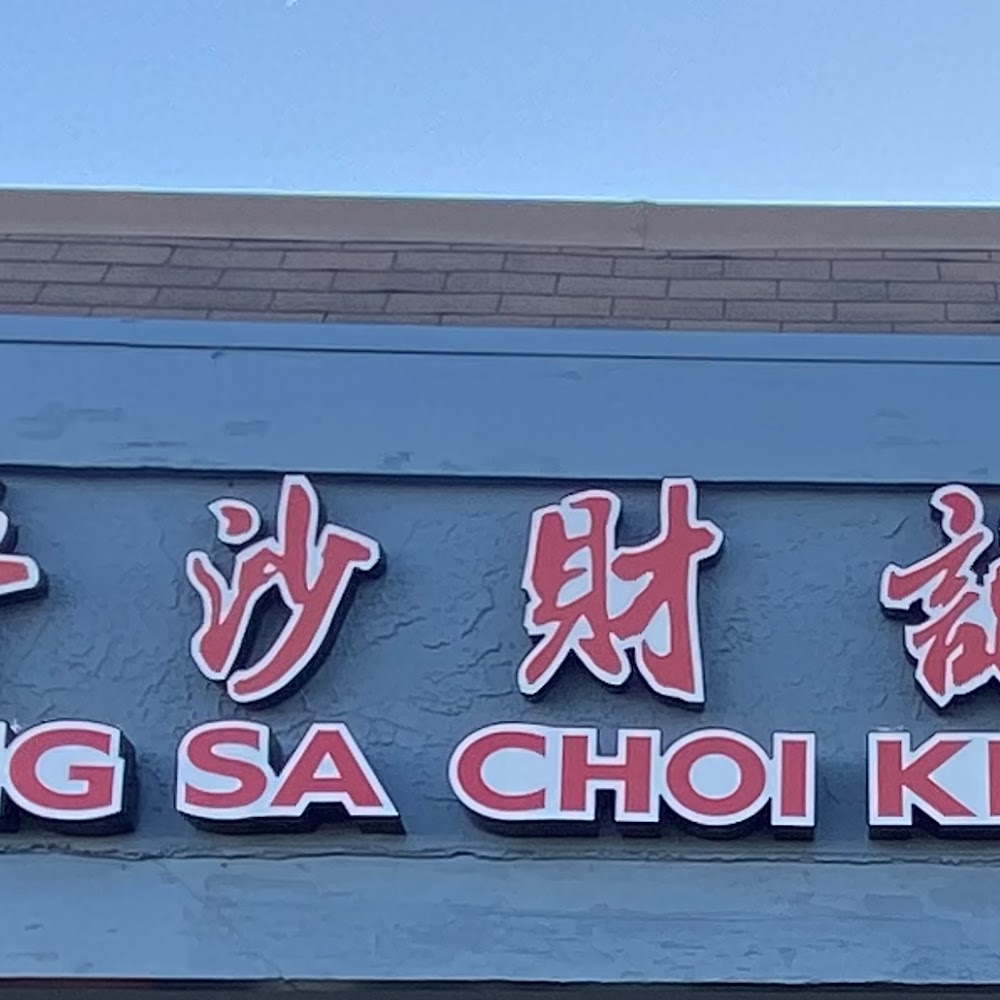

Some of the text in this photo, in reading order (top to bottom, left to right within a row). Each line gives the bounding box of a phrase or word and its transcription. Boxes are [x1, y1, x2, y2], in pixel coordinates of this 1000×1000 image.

[0, 722, 125, 821] G
[177, 722, 398, 819] SA
[449, 726, 816, 827] CHOI
